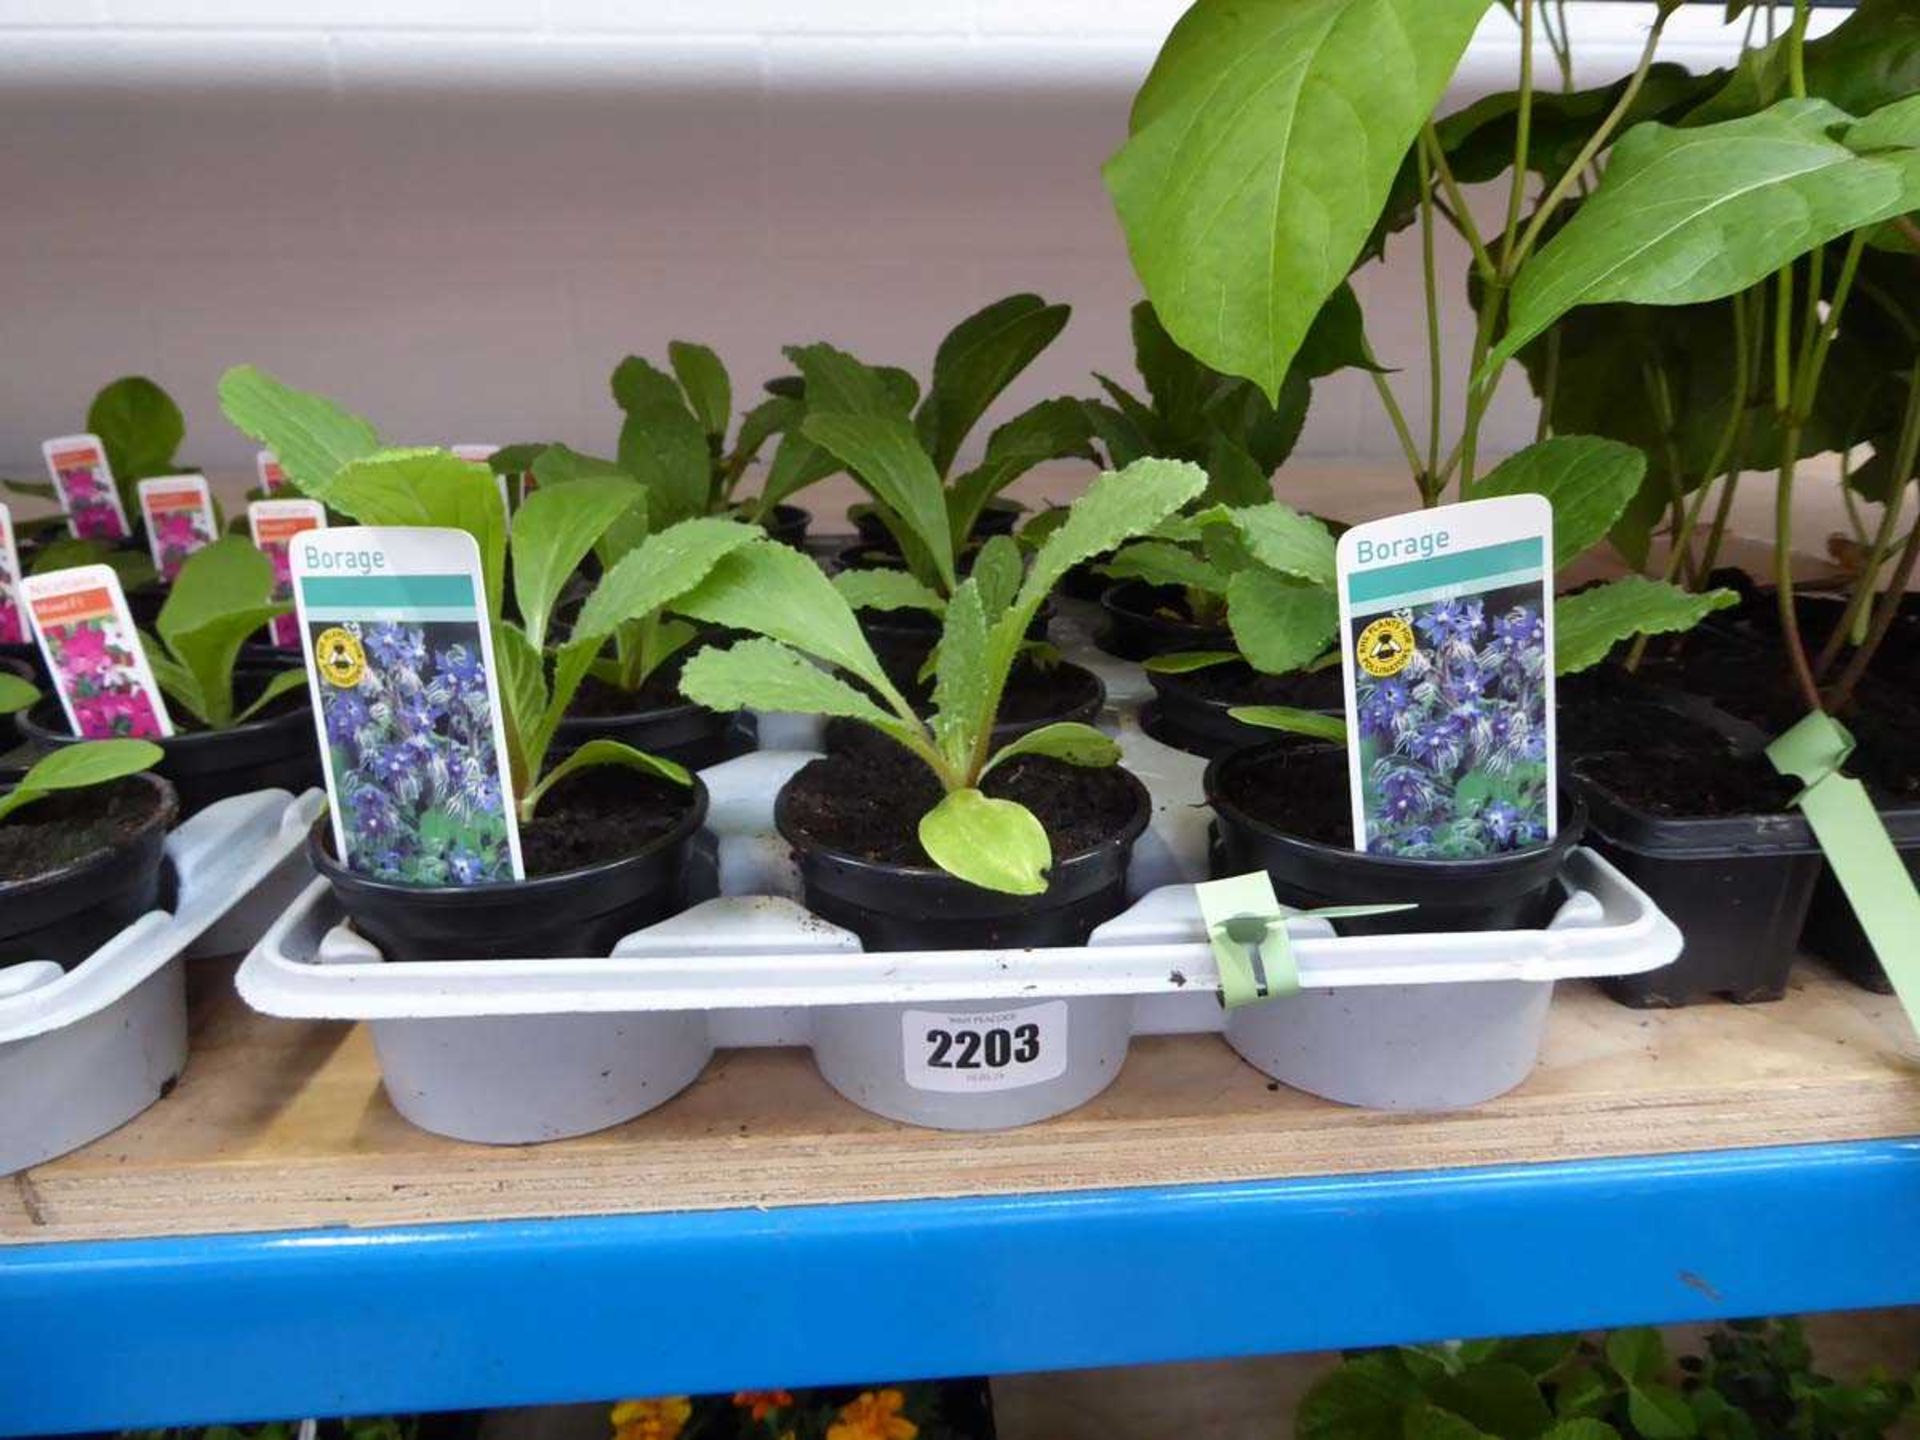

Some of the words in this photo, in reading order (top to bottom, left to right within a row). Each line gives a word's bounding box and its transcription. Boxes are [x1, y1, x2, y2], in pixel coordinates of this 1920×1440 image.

[305, 545, 385, 574] Borage
[1357, 530, 1449, 564] Borage
[926, 1023, 1040, 1068] 2203
